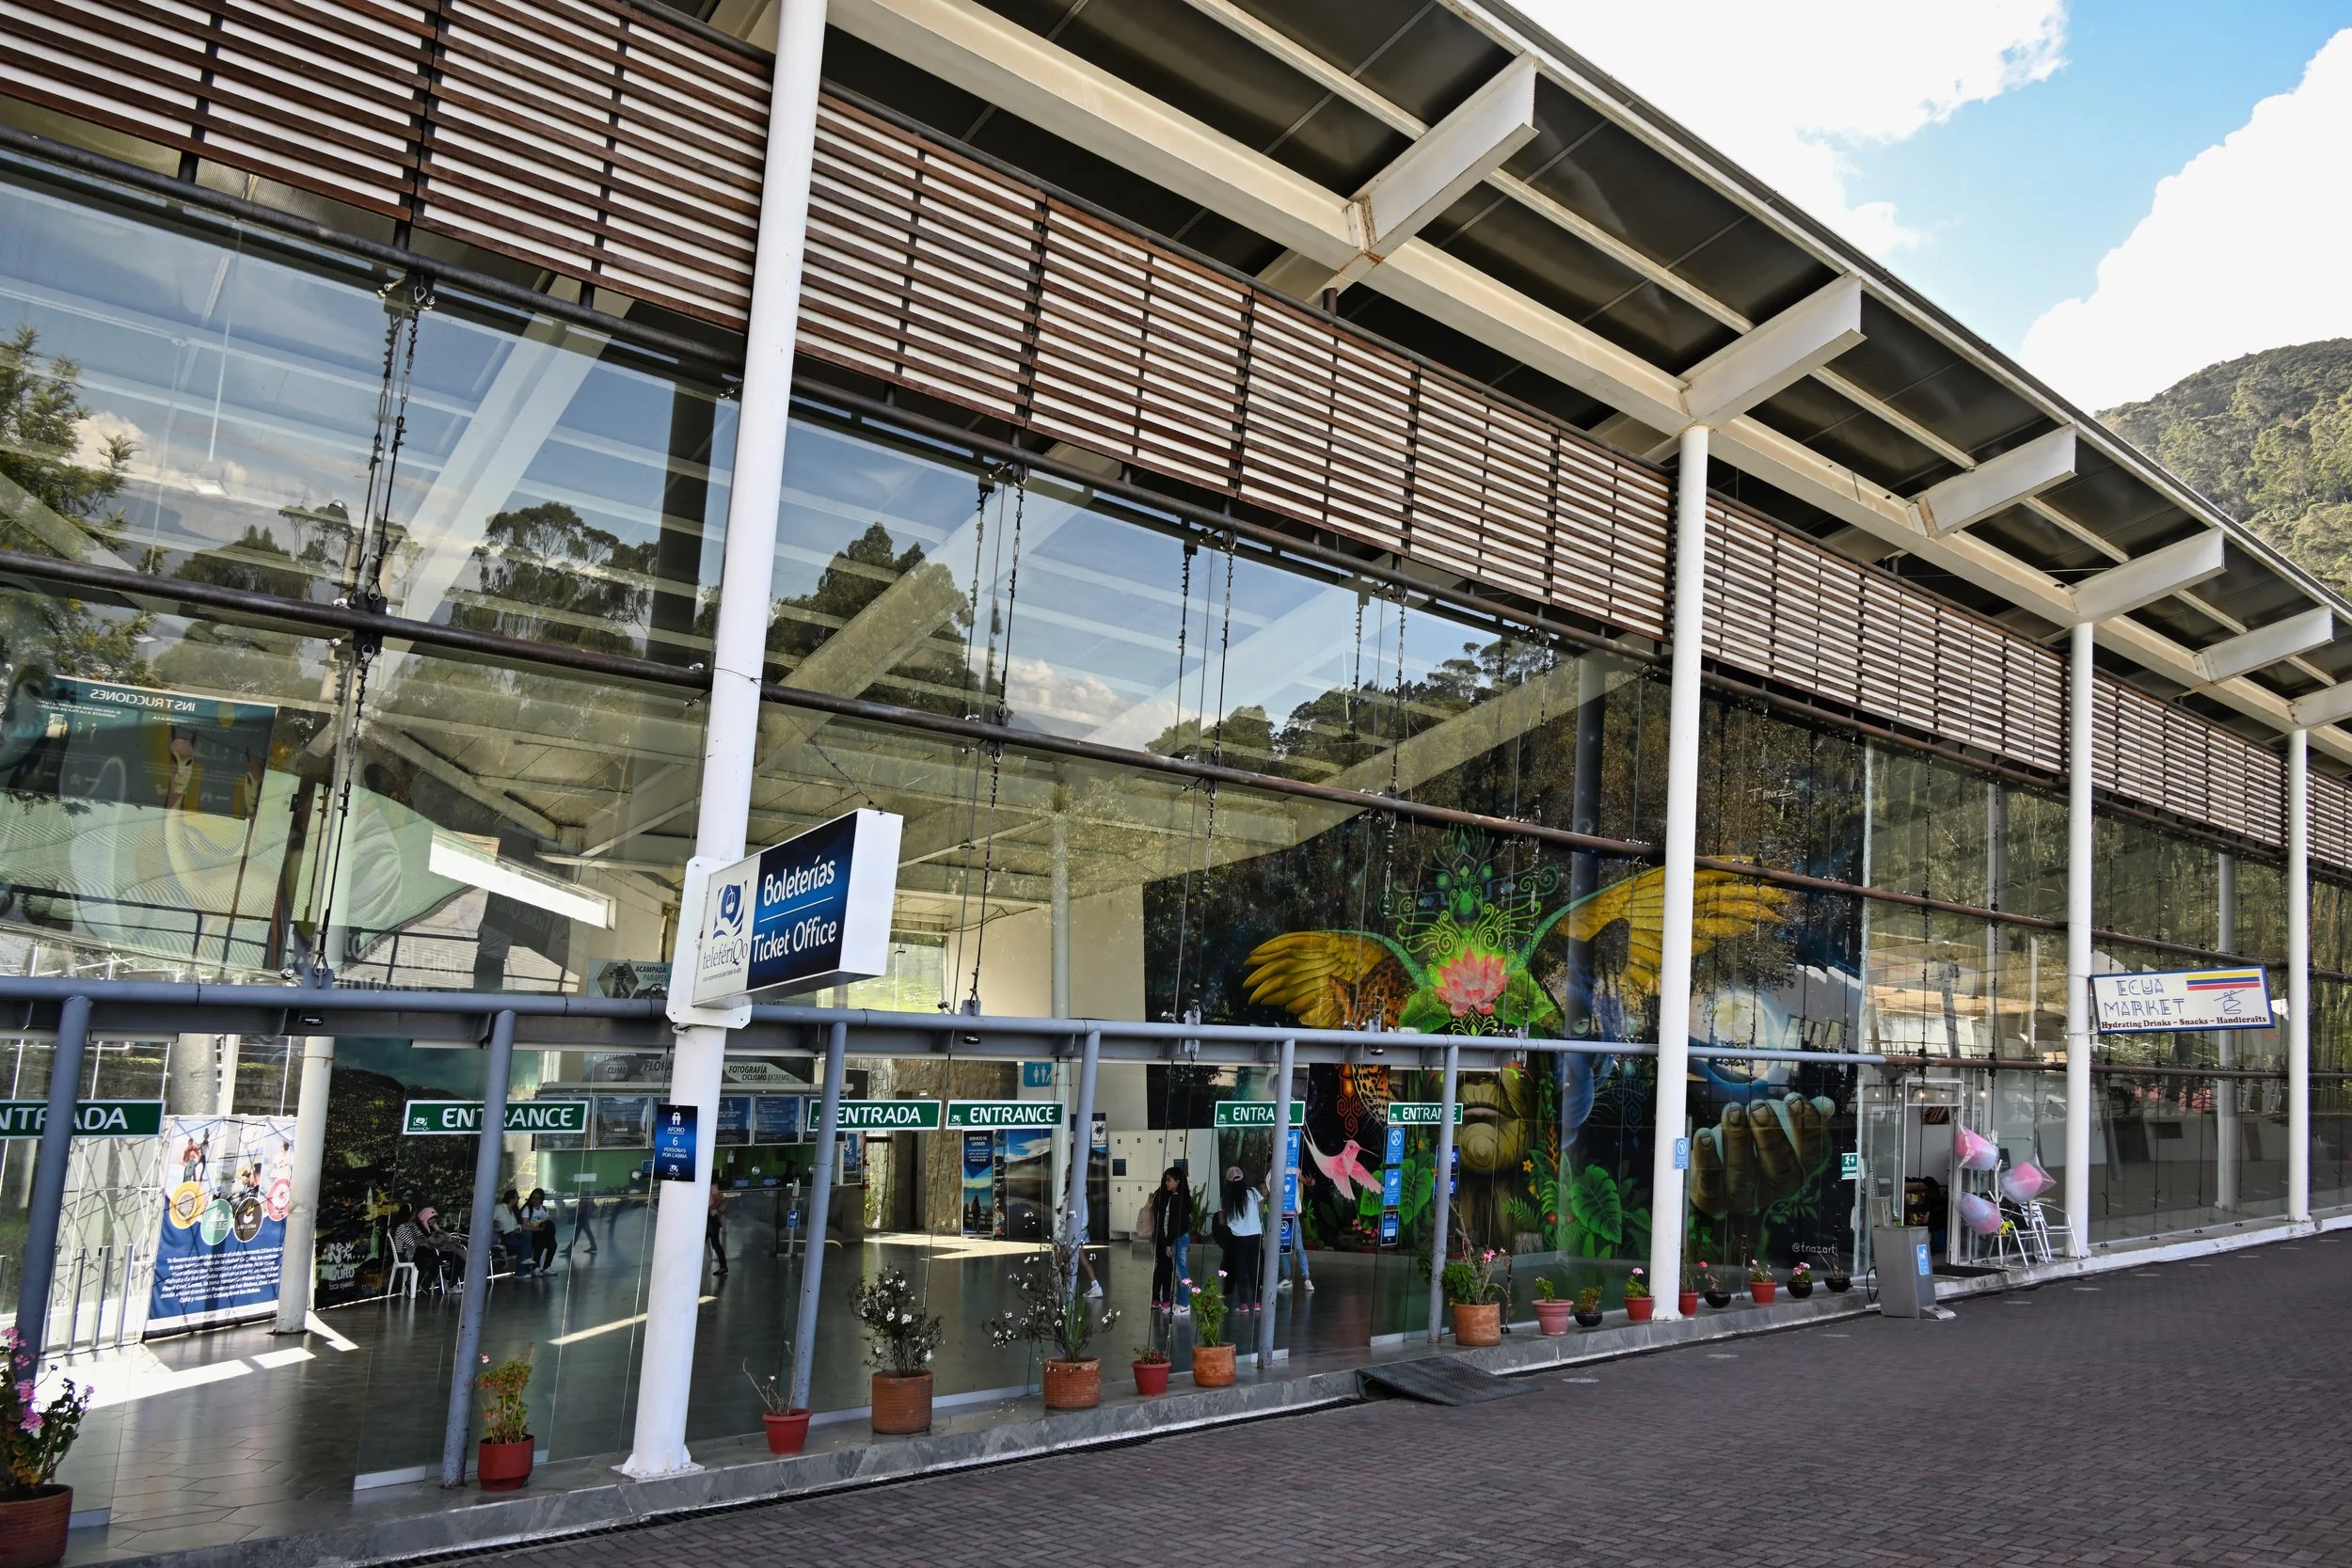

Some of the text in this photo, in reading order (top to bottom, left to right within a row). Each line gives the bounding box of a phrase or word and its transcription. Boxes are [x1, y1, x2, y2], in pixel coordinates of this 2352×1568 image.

[763, 854, 835, 907] Boleterías
[753, 915, 836, 963] Ticket Office
[635, 965, 667, 974] ACAMPADA
[642, 974, 672, 983] PARAPENT
[2116, 978, 2165, 996] ECUA
[2104, 998, 2185, 1018] MARKET
[2101, 1022, 2142, 1030] Hydrating
[2217, 1016, 2267, 1024] Handicrafts
[728, 1065, 768, 1074] FOTOGRAFÍA
[836, 1106, 922, 1124] ENTRADA
[969, 1106, 1056, 1123] ENTRANCE
[1232, 1107, 1292, 1121] ENTRA
[672, 1136, 678, 1146] 6
